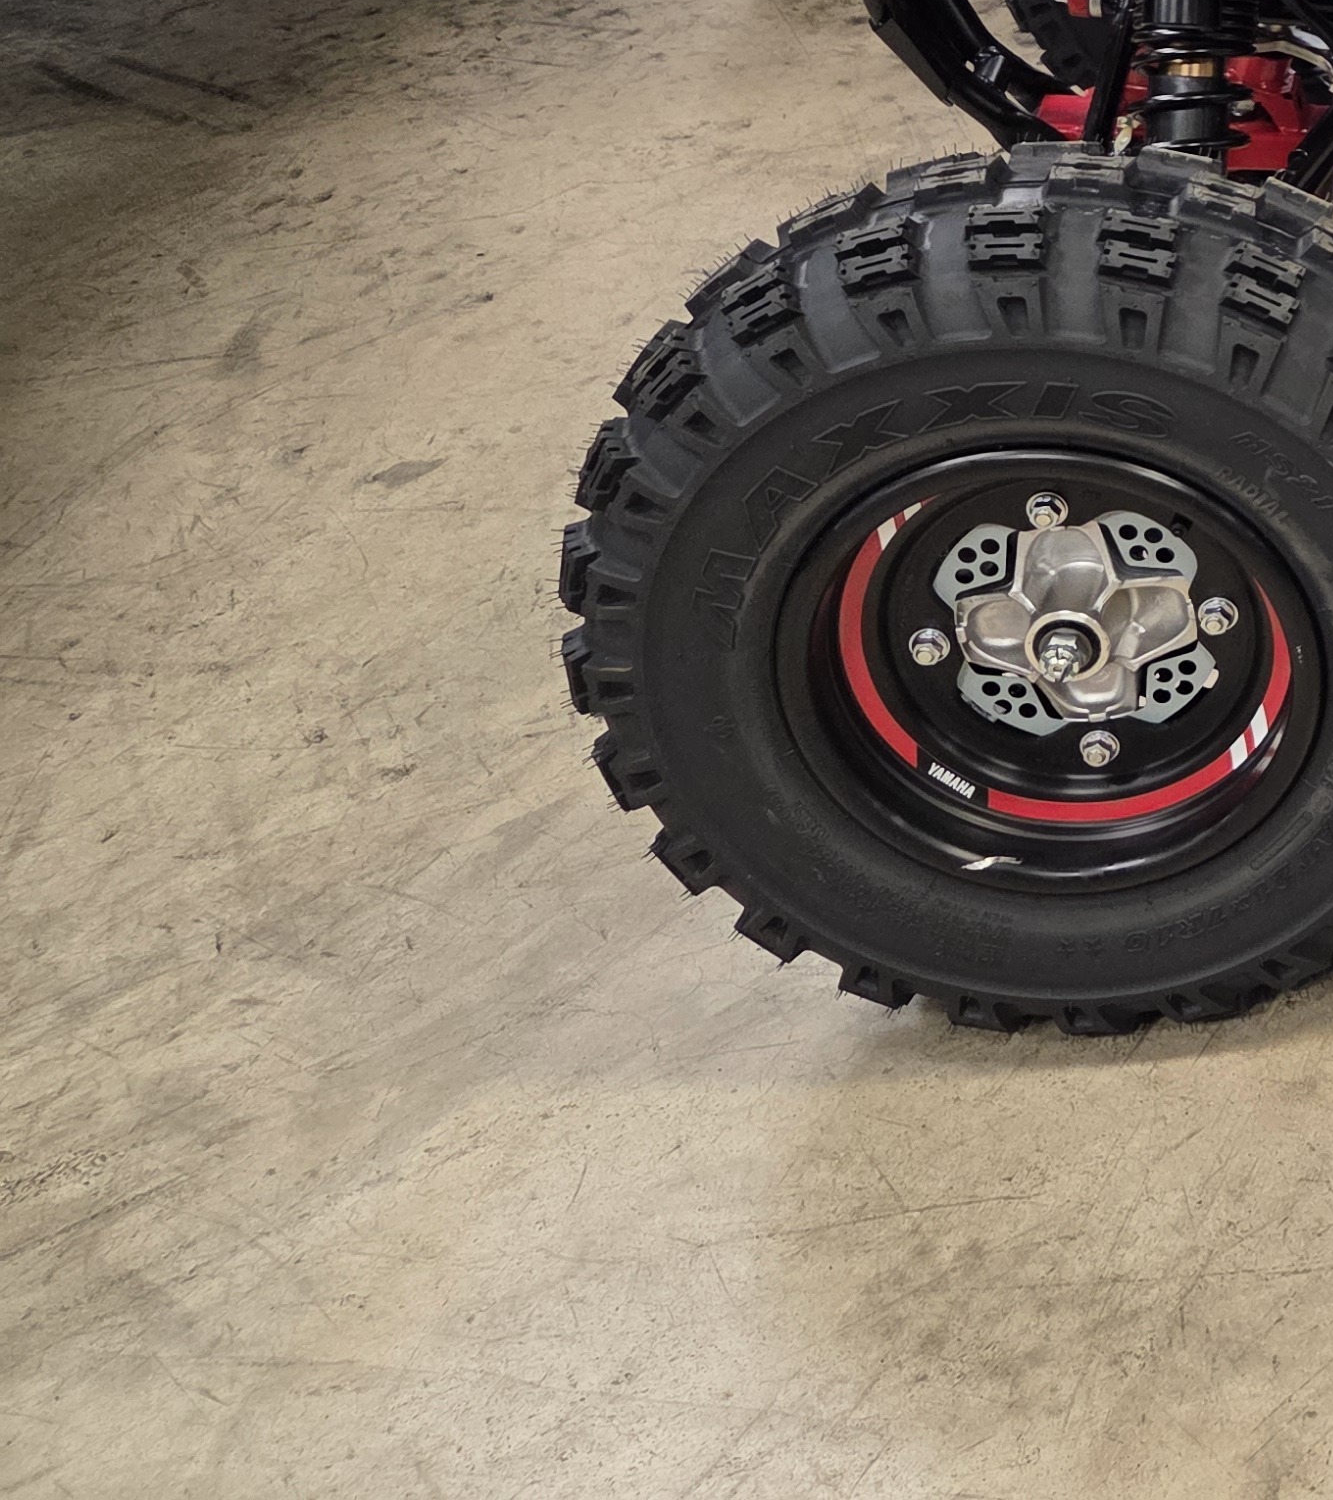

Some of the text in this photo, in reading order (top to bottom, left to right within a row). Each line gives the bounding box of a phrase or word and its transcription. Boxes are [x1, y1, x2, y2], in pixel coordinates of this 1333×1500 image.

[690, 380, 1177, 652] MAXXIS
[1215, 466, 1290, 524] RADIAL
[926, 761, 976, 800] YAMAHA
